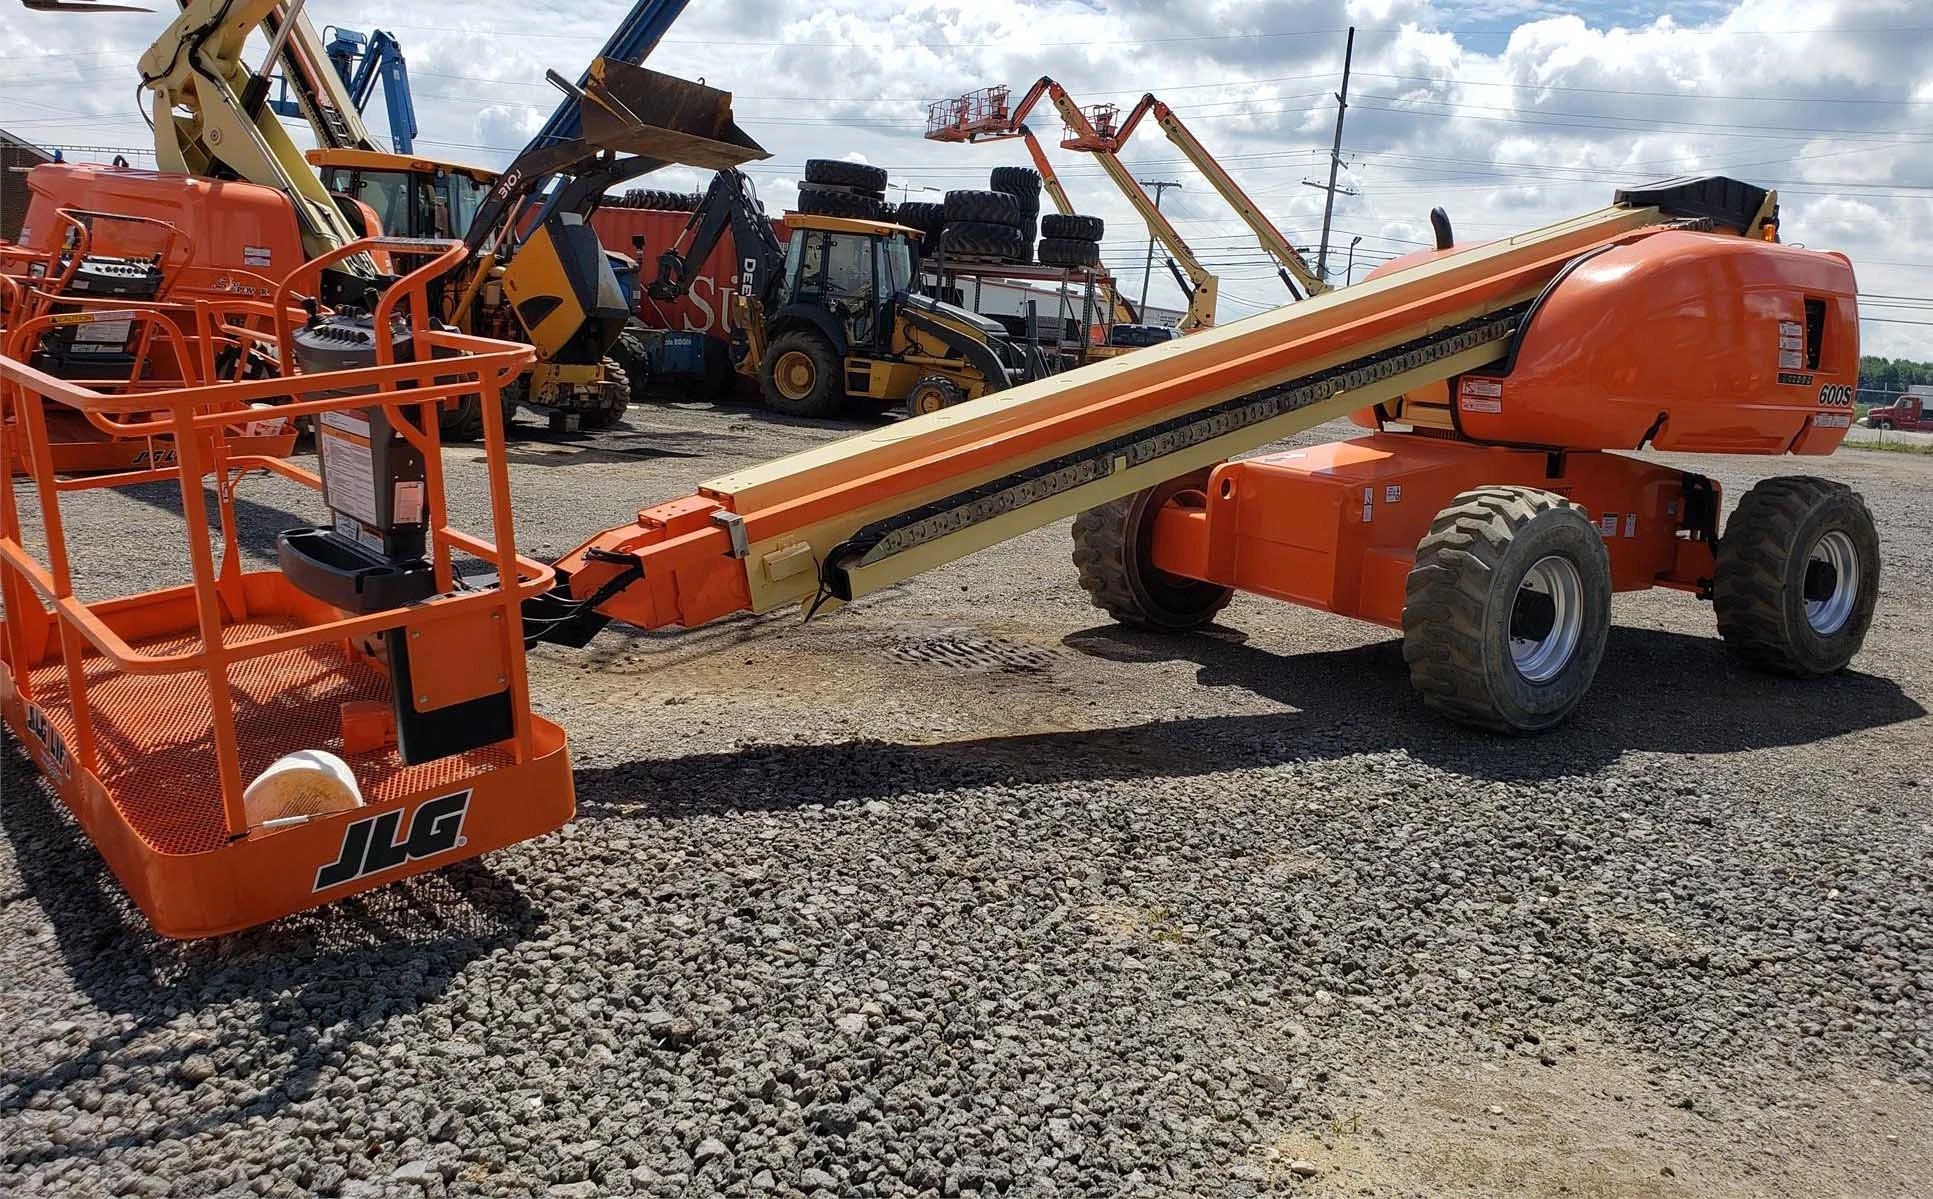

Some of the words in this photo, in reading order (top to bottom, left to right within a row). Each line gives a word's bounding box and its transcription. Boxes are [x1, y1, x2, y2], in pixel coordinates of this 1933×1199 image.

[498, 169, 522, 199] 310J
[59, 313, 93, 323] CAUTION
[1819, 385, 1852, 406] 600S
[312, 788, 474, 893] JLG
